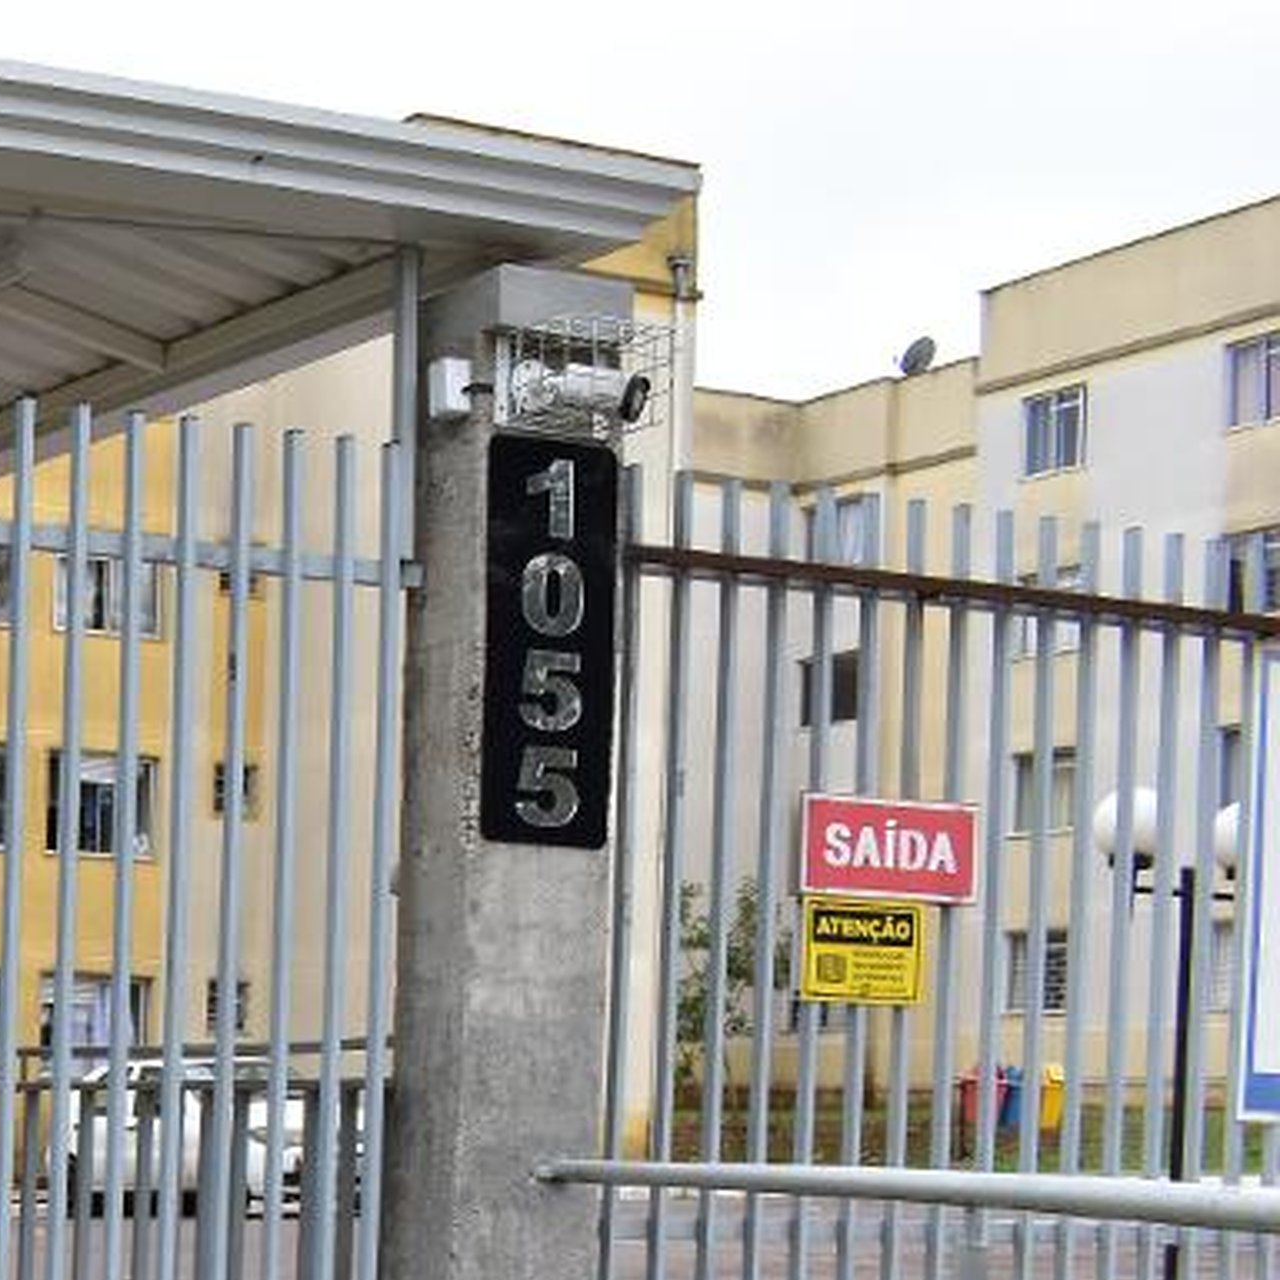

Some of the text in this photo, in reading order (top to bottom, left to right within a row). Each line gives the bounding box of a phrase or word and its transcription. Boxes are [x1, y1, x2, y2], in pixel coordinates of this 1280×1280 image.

[515, 459, 584, 828] 1055
[824, 819, 960, 874] SAÍDA
[815, 915, 911, 945] ATENÇÃO
